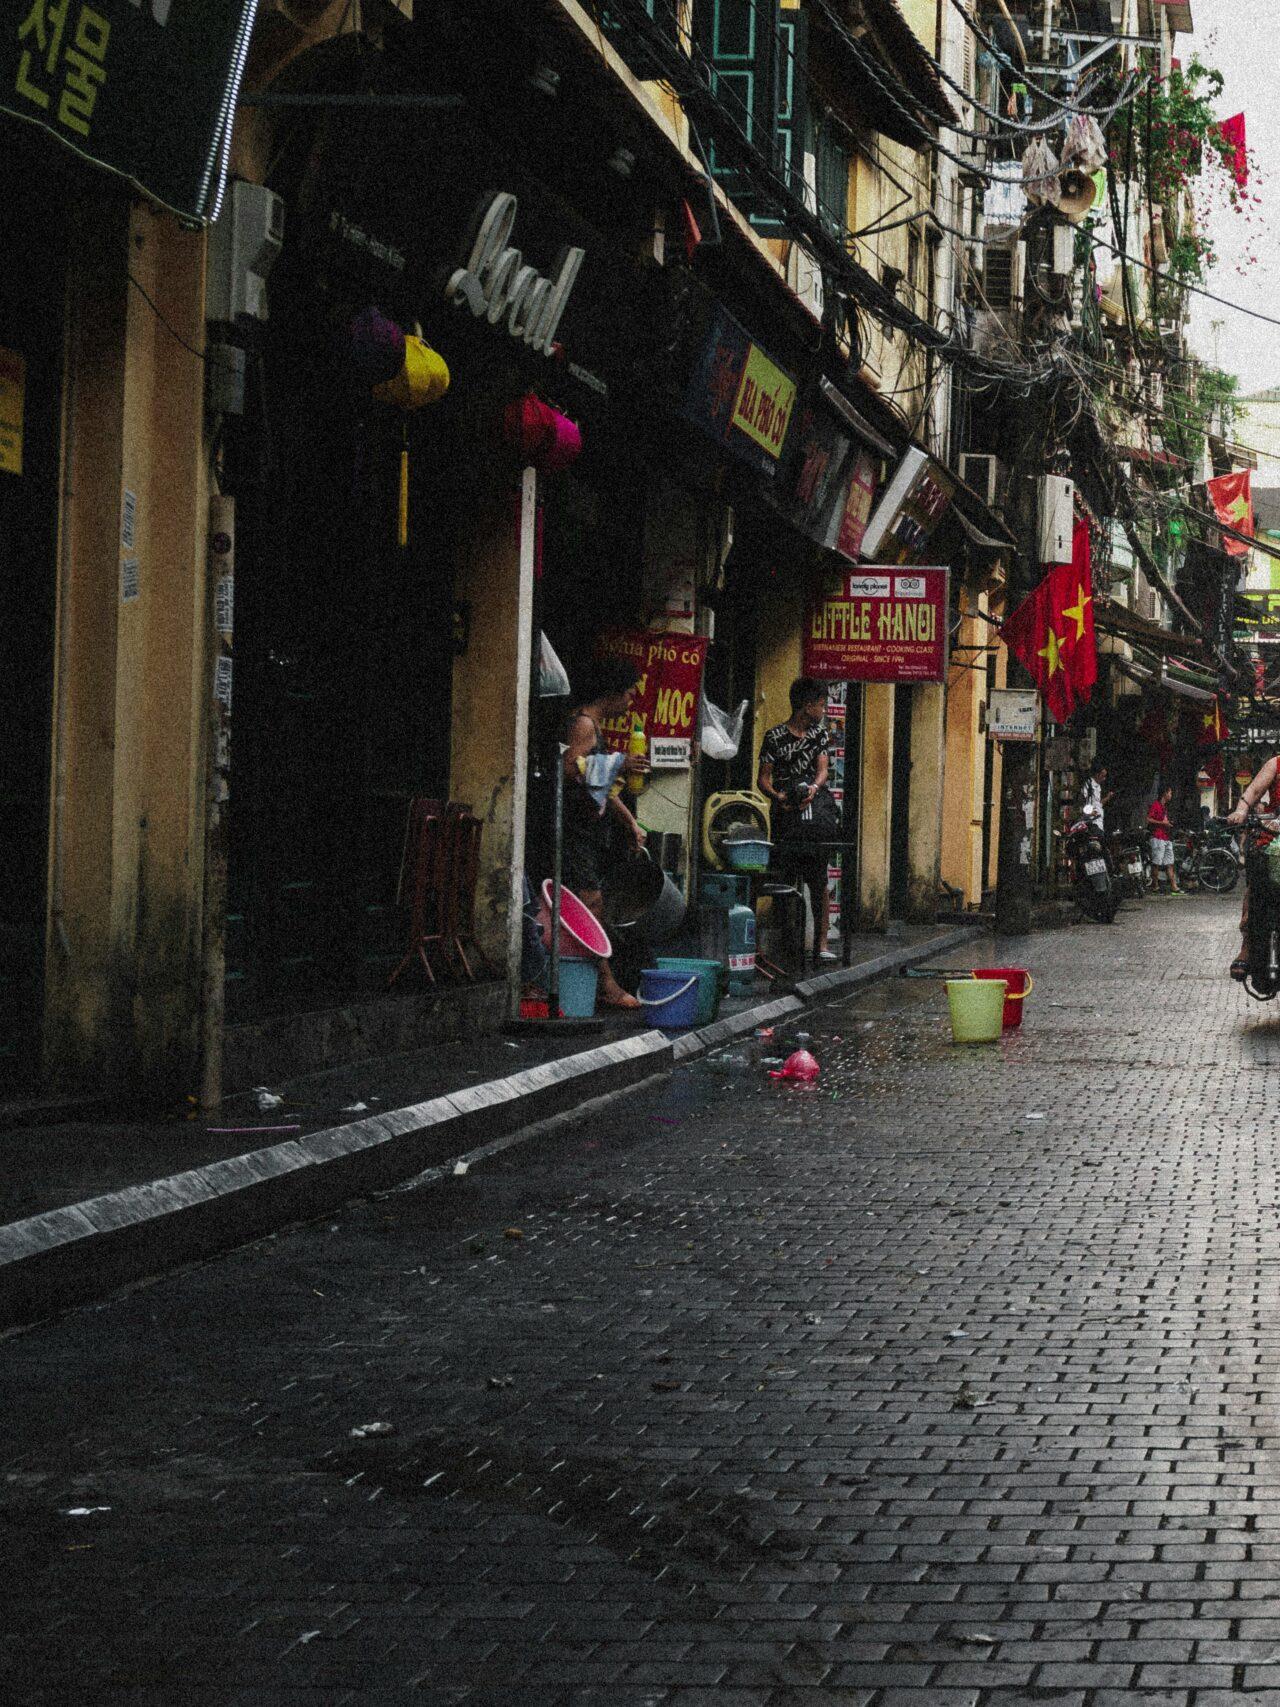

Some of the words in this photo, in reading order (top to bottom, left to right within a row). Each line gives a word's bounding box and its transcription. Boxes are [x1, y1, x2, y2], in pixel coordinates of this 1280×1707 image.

[15, 0, 112, 137] 선물
[811, 601, 872, 640] LITTLE
[877, 602, 936, 642] HANOI
[840, 654, 869, 663] ORIGINAL
[873, 655, 891, 664] SINCE
[847, 643, 882, 653] RESTAURANT
[886, 645, 915, 653] COOKING
[915, 646, 934, 654] CLASS
[653, 687, 695, 736] MỌC
